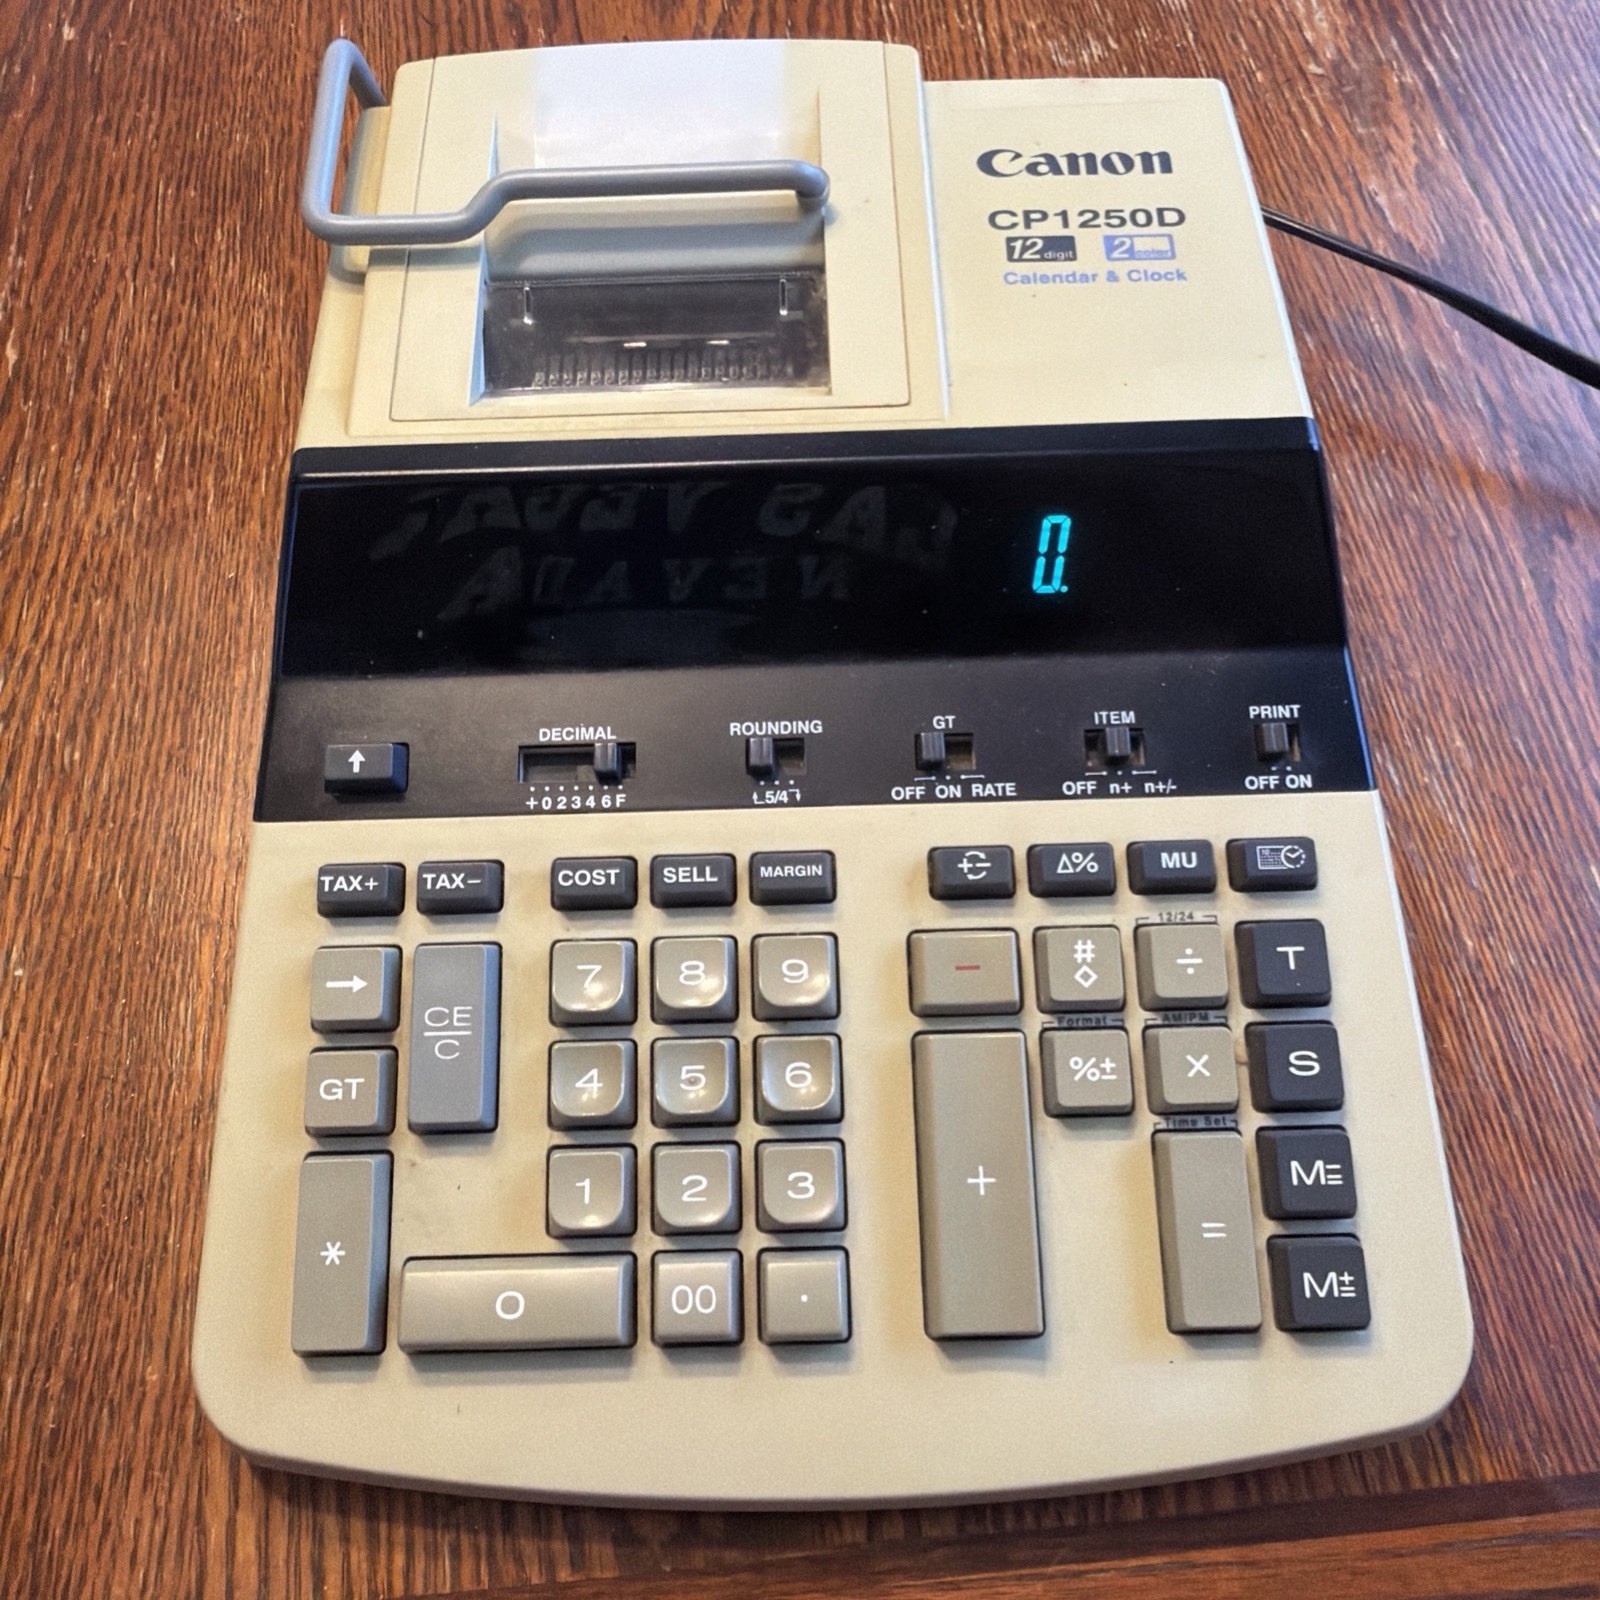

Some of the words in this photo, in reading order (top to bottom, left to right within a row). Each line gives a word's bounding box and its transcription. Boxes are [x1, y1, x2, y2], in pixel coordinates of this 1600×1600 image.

[976, 148, 1174, 178] Canon
[987, 207, 1186, 230] CP1250D
[1009, 238, 1044, 260] 12
[1044, 250, 1074, 262] digit
[1110, 236, 1132, 259] 2
[1003, 270, 1098, 285] Calendar
[1106, 270, 1120, 283] &
[1127, 268, 1188, 282] Clock
[932, 715, 956, 730] GT
[1094, 710, 1136, 725] ITEM
[1249, 704, 1300, 720] PRINT
[539, 726, 617, 742] DECIMAL
[729, 720, 823, 736] ROUNDING
[890, 786, 926, 800] OFF
[935, 784, 962, 799] ON
[971, 782, 1018, 798] RATE
[1062, 781, 1098, 796] OFF
[1109, 781, 1132, 794] n+
[1244, 775, 1280, 790] OFF
[1285, 774, 1313, 789] ON
[759, 863, 824, 879] MARGIN
[1160, 851, 1198, 870] MU
[320, 875, 378, 892] TAX+
[557, 868, 622, 887] COST
[662, 866, 718, 884] SELL
[1158, 911, 1194, 922] 12/24
[1276, 946, 1305, 970] T
[576, 964, 602, 990] 7
[679, 960, 706, 986] 8
[781, 958, 809, 984] 9
[424, 1006, 473, 1028] CE
[1056, 1015, 1108, 1028] Format
[1162, 1012, 1210, 1024] AM/PM
[434, 1039, 460, 1060] C
[1288, 1050, 1321, 1077] S
[574, 1068, 603, 1096] 4
[679, 1065, 707, 1091] 5
[784, 1061, 813, 1089] 6
[318, 1078, 365, 1100] GT
[1163, 1116, 1202, 1128] Time
[1204, 1116, 1228, 1128] Set
[575, 1178, 591, 1205] 1
[682, 1174, 709, 1202] 2
[786, 1171, 816, 1200] 3
[671, 1284, 717, 1315] 00
